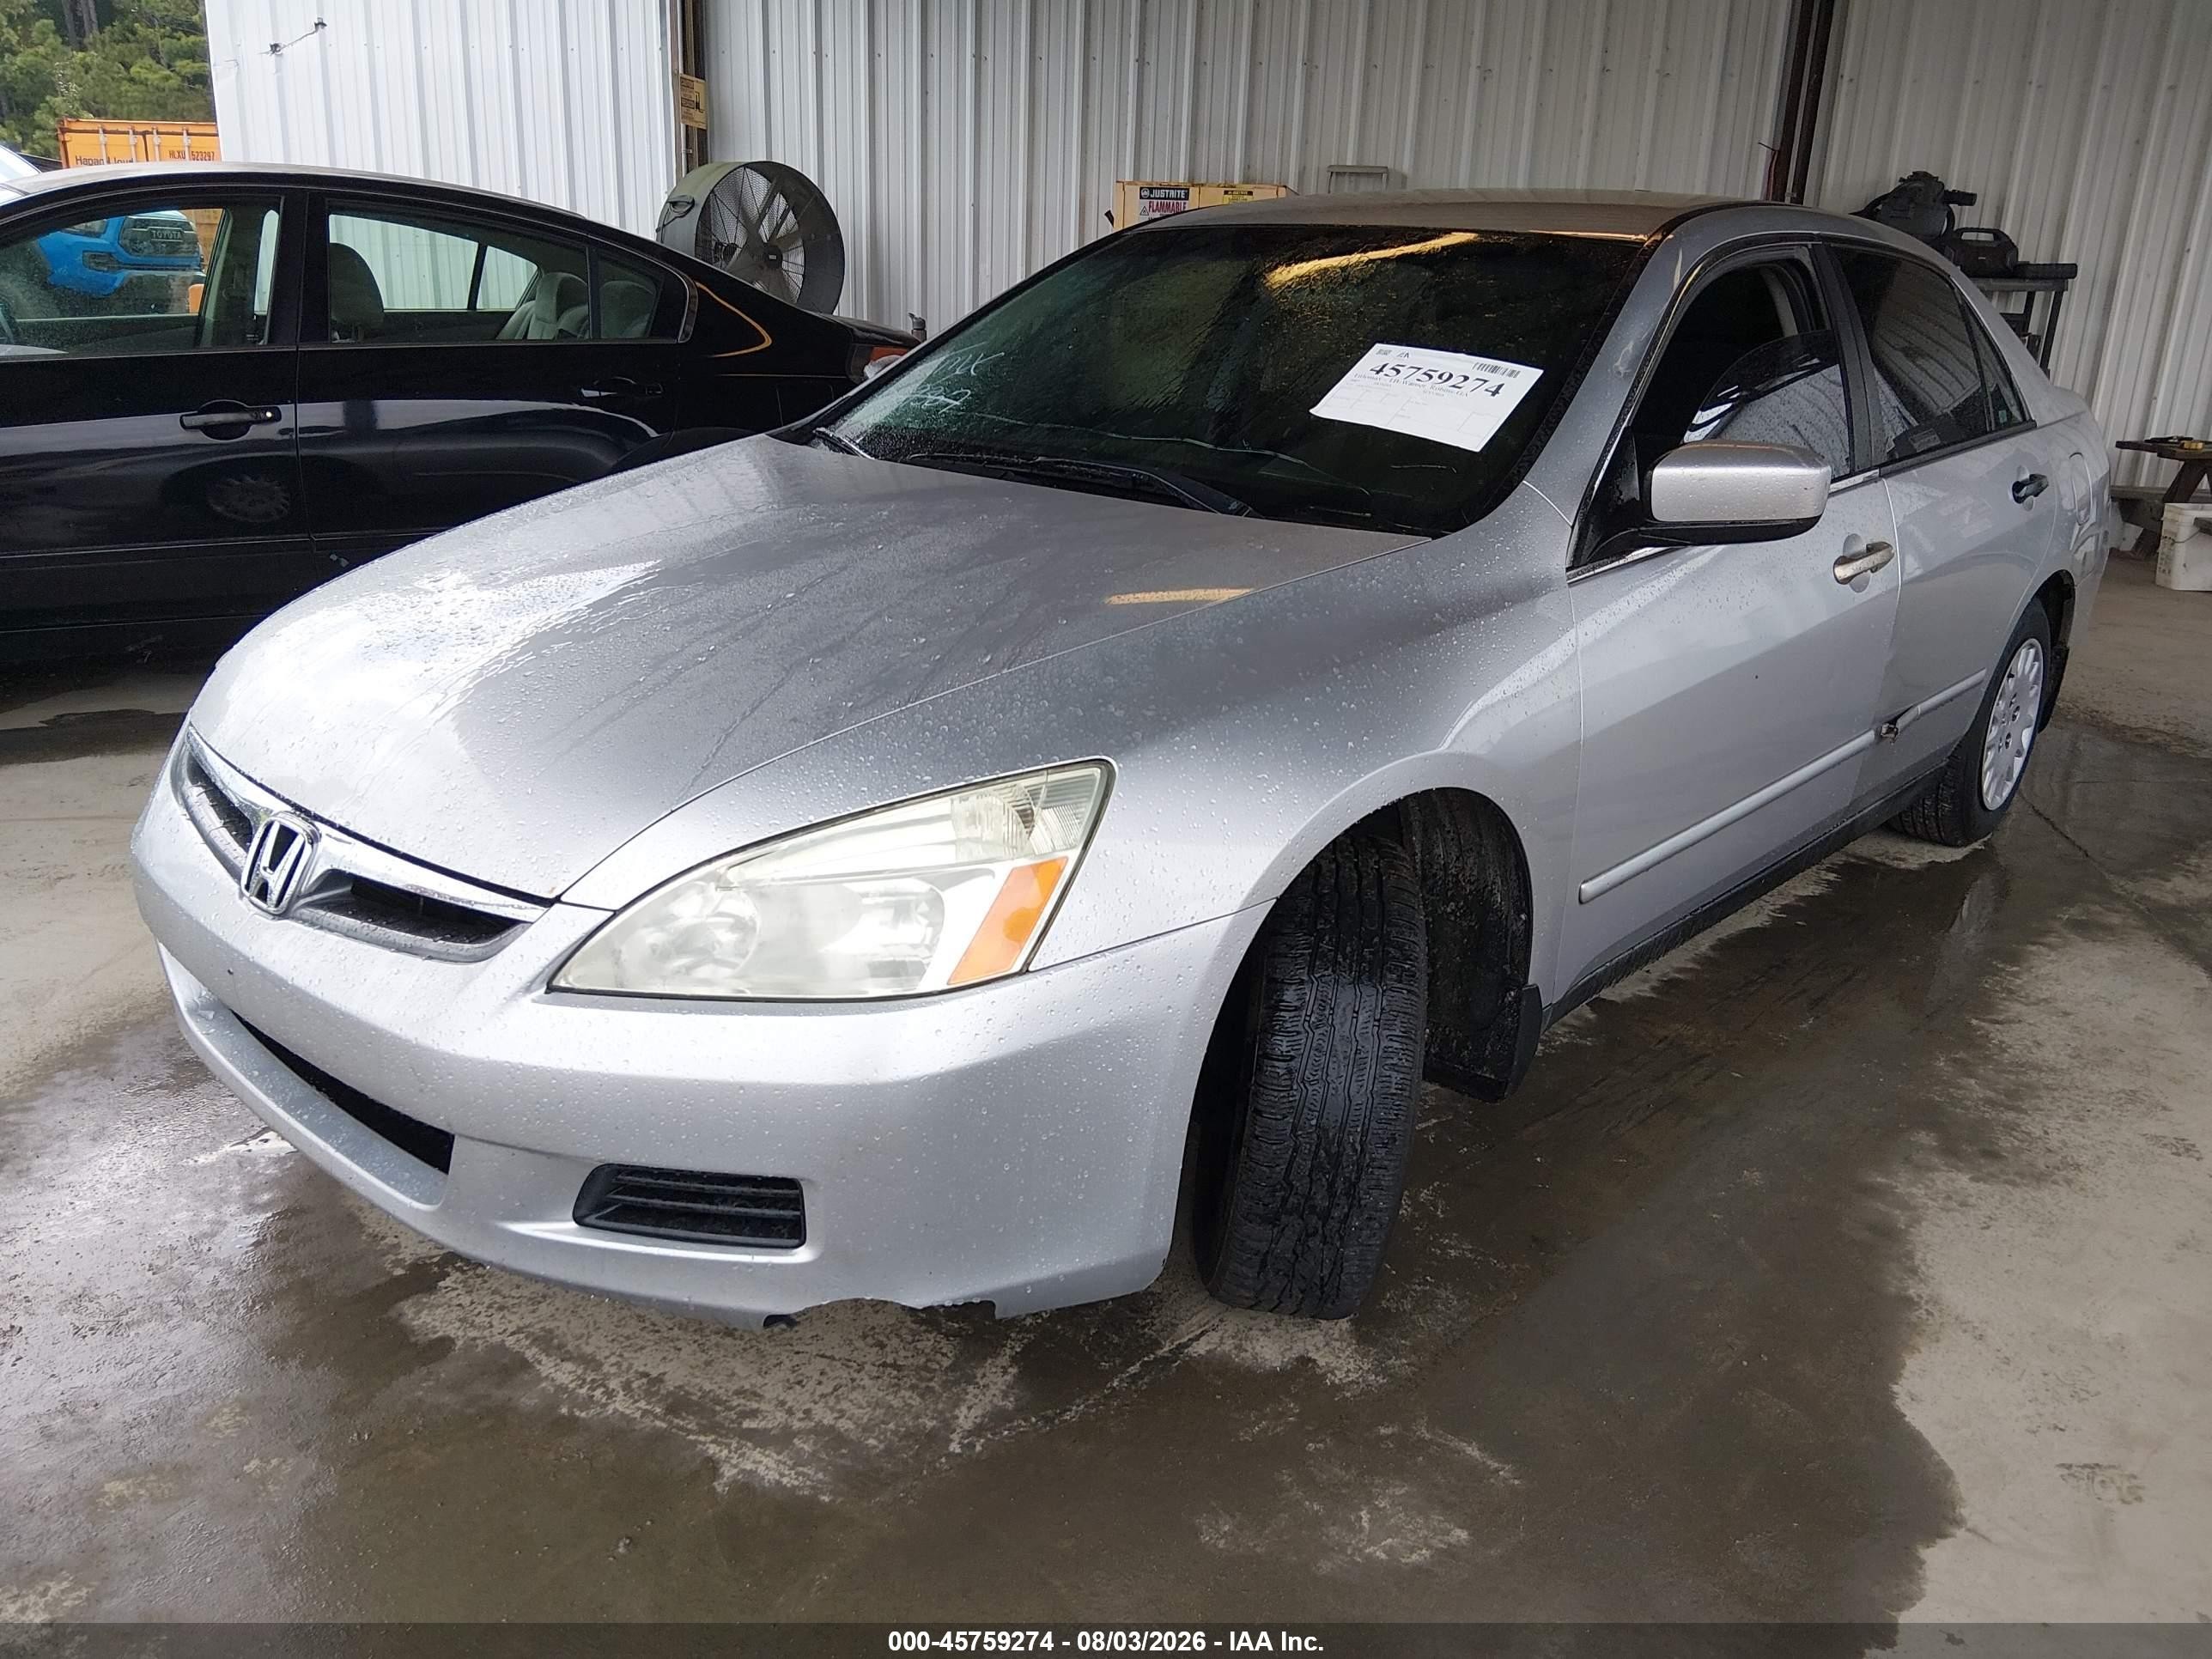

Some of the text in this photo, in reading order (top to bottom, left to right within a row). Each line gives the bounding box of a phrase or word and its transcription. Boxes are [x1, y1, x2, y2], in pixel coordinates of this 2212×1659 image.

[169, 150, 215, 161] HLXU 523297
[1150, 188, 1185, 198] JUSTRITE
[1148, 200, 1187, 213] FLAMMABLE
[151, 229, 182, 240] TOYOTA
[1370, 362, 1505, 398] 45759274
